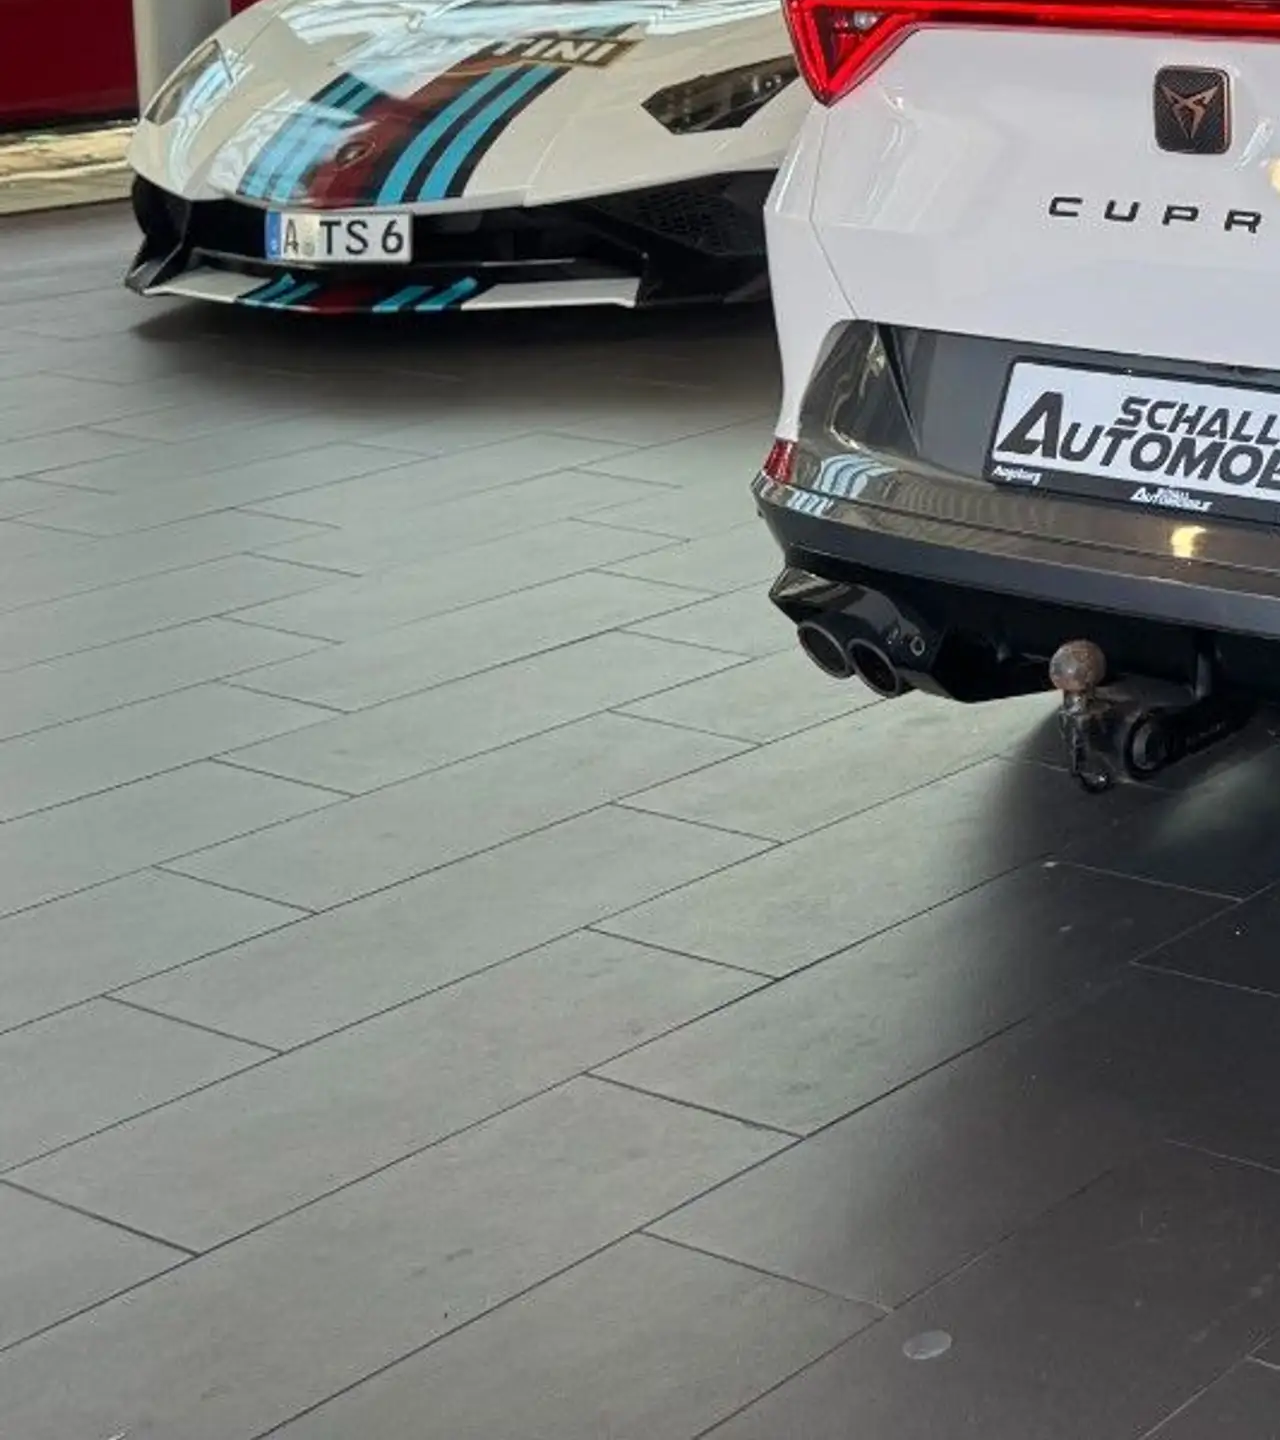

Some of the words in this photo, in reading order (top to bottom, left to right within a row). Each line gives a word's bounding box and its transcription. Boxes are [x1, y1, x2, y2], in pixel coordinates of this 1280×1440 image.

[284, 219, 298, 254] A
[319, 220, 368, 255] TS
[381, 220, 403, 254] 6
[1114, 397, 1280, 444] SCHALL
